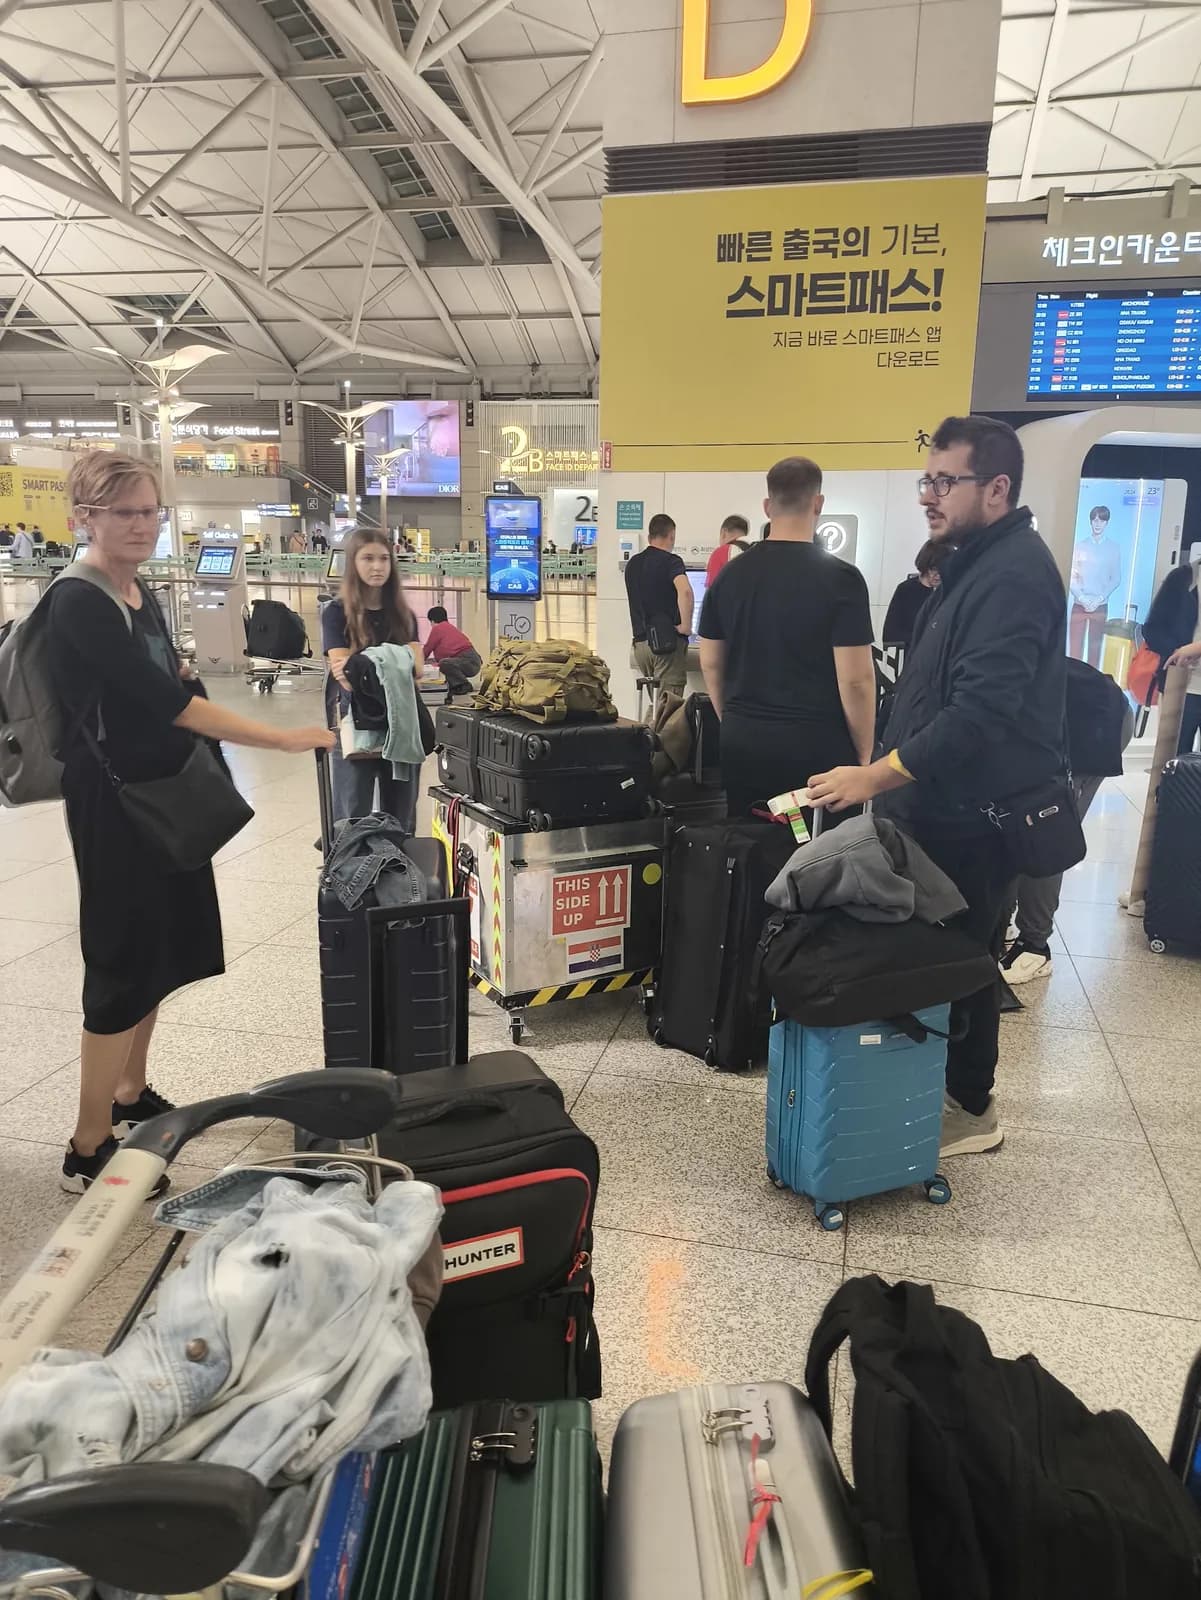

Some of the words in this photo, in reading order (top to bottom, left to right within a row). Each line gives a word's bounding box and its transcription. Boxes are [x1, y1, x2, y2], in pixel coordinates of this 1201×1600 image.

[681, 0, 815, 106] D
[716, 230, 773, 263] 빠른
[782, 226, 870, 260] 출국의
[881, 223, 948, 257] 기본,
[726, 268, 945, 318] 스마트패스!
[773, 331, 802, 348] 지금
[808, 329, 838, 347] 바로
[842, 327, 921, 346] 스마트패스
[926, 326, 942, 343] 앱
[877, 350, 939, 369] 다운로드
[213, 425, 234, 436] Food
[234, 426, 260, 436] Street
[23, 479, 49, 491] SMART
[438, 484, 459, 493] DIOR
[555, 877, 591, 893] THIS
[555, 894, 591, 911] SIDE
[563, 912, 584, 926] UP
[444, 1243, 516, 1270] HUNTER
